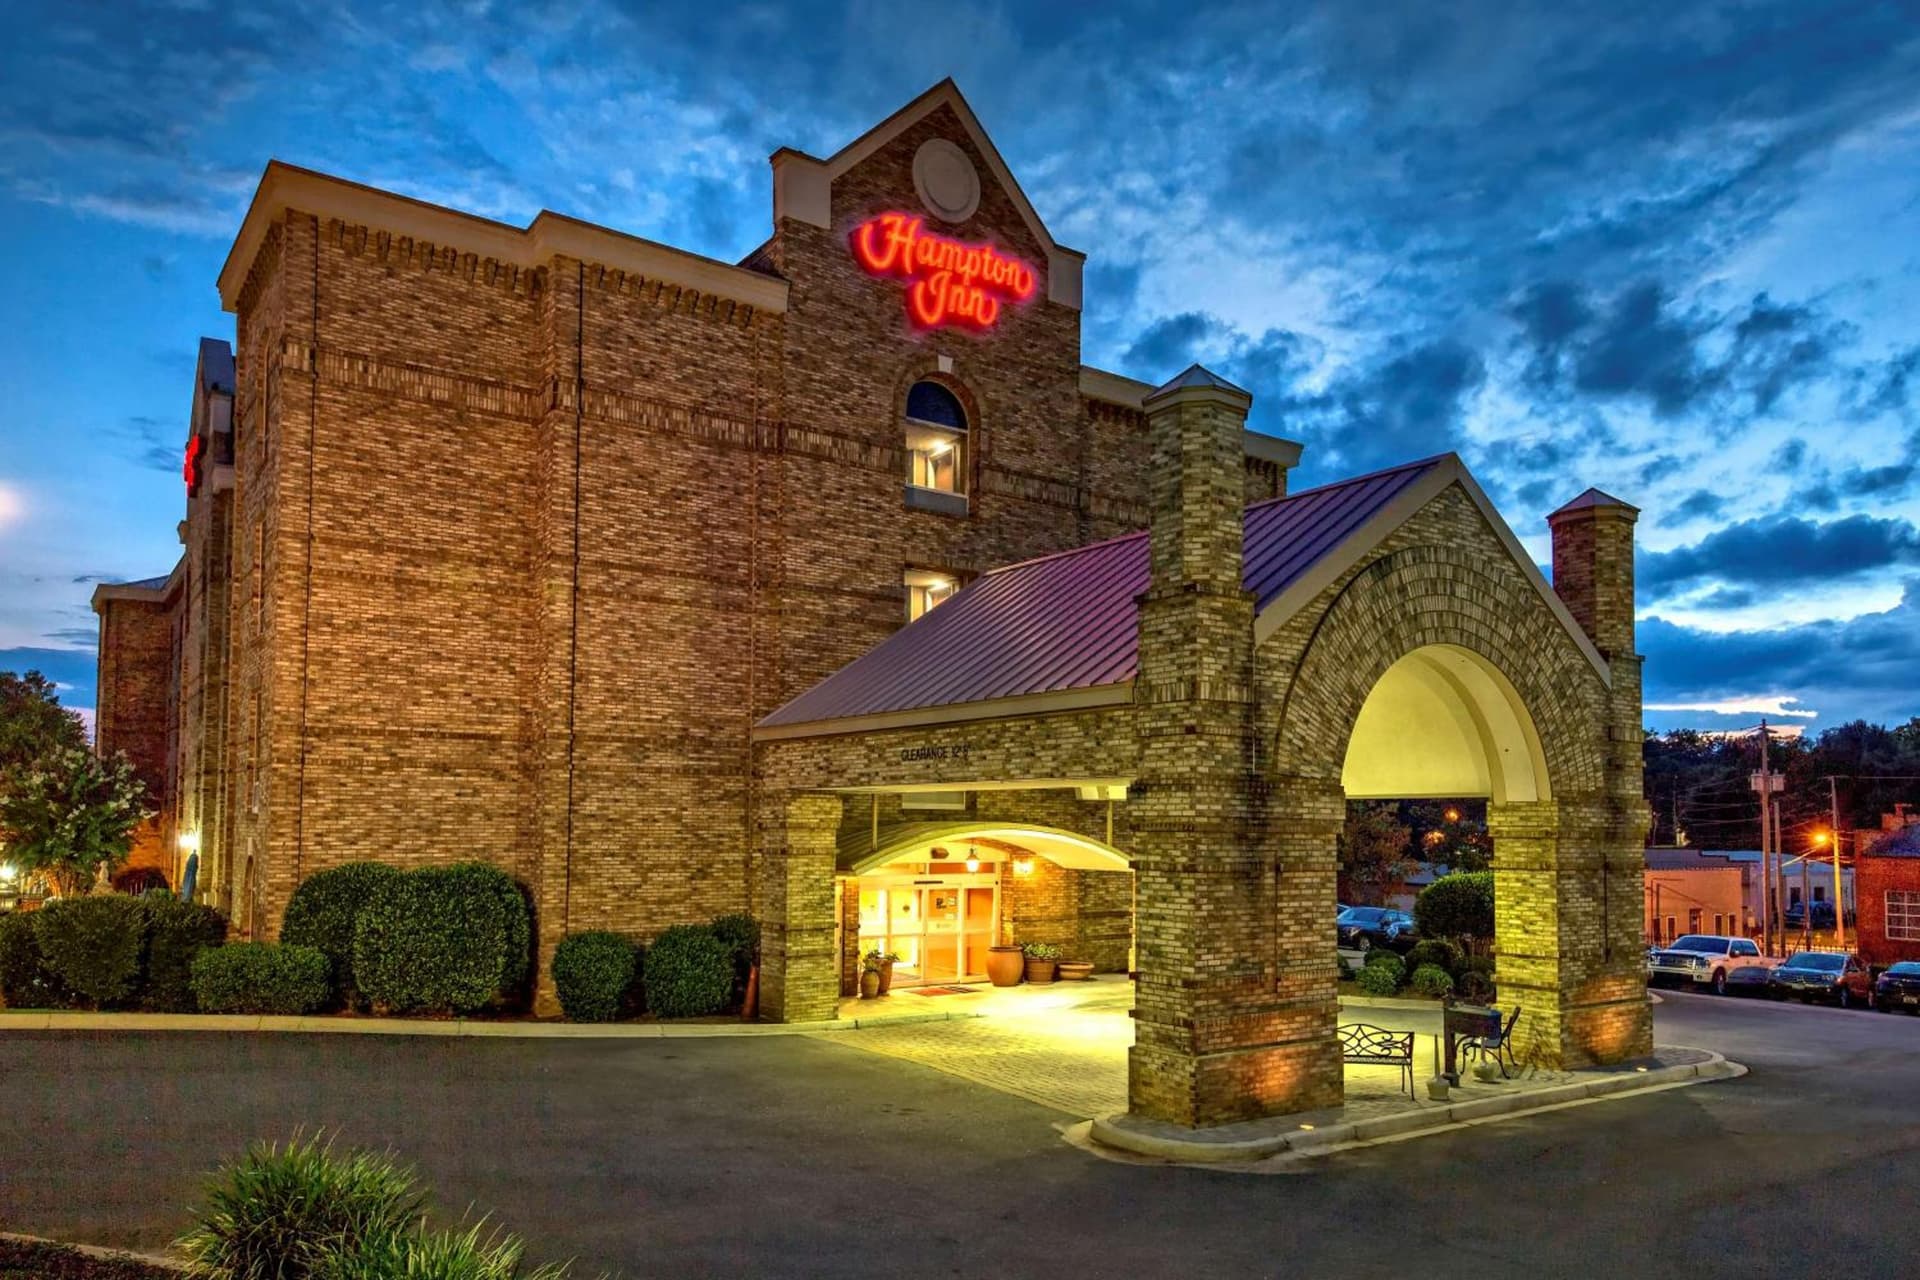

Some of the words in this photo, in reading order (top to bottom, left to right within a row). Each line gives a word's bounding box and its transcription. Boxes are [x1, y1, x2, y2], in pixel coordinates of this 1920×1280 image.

[858, 213, 1034, 296] Hampton
[913, 271, 999, 325] Inn
[901, 746, 948, 761] CLEARANCE
